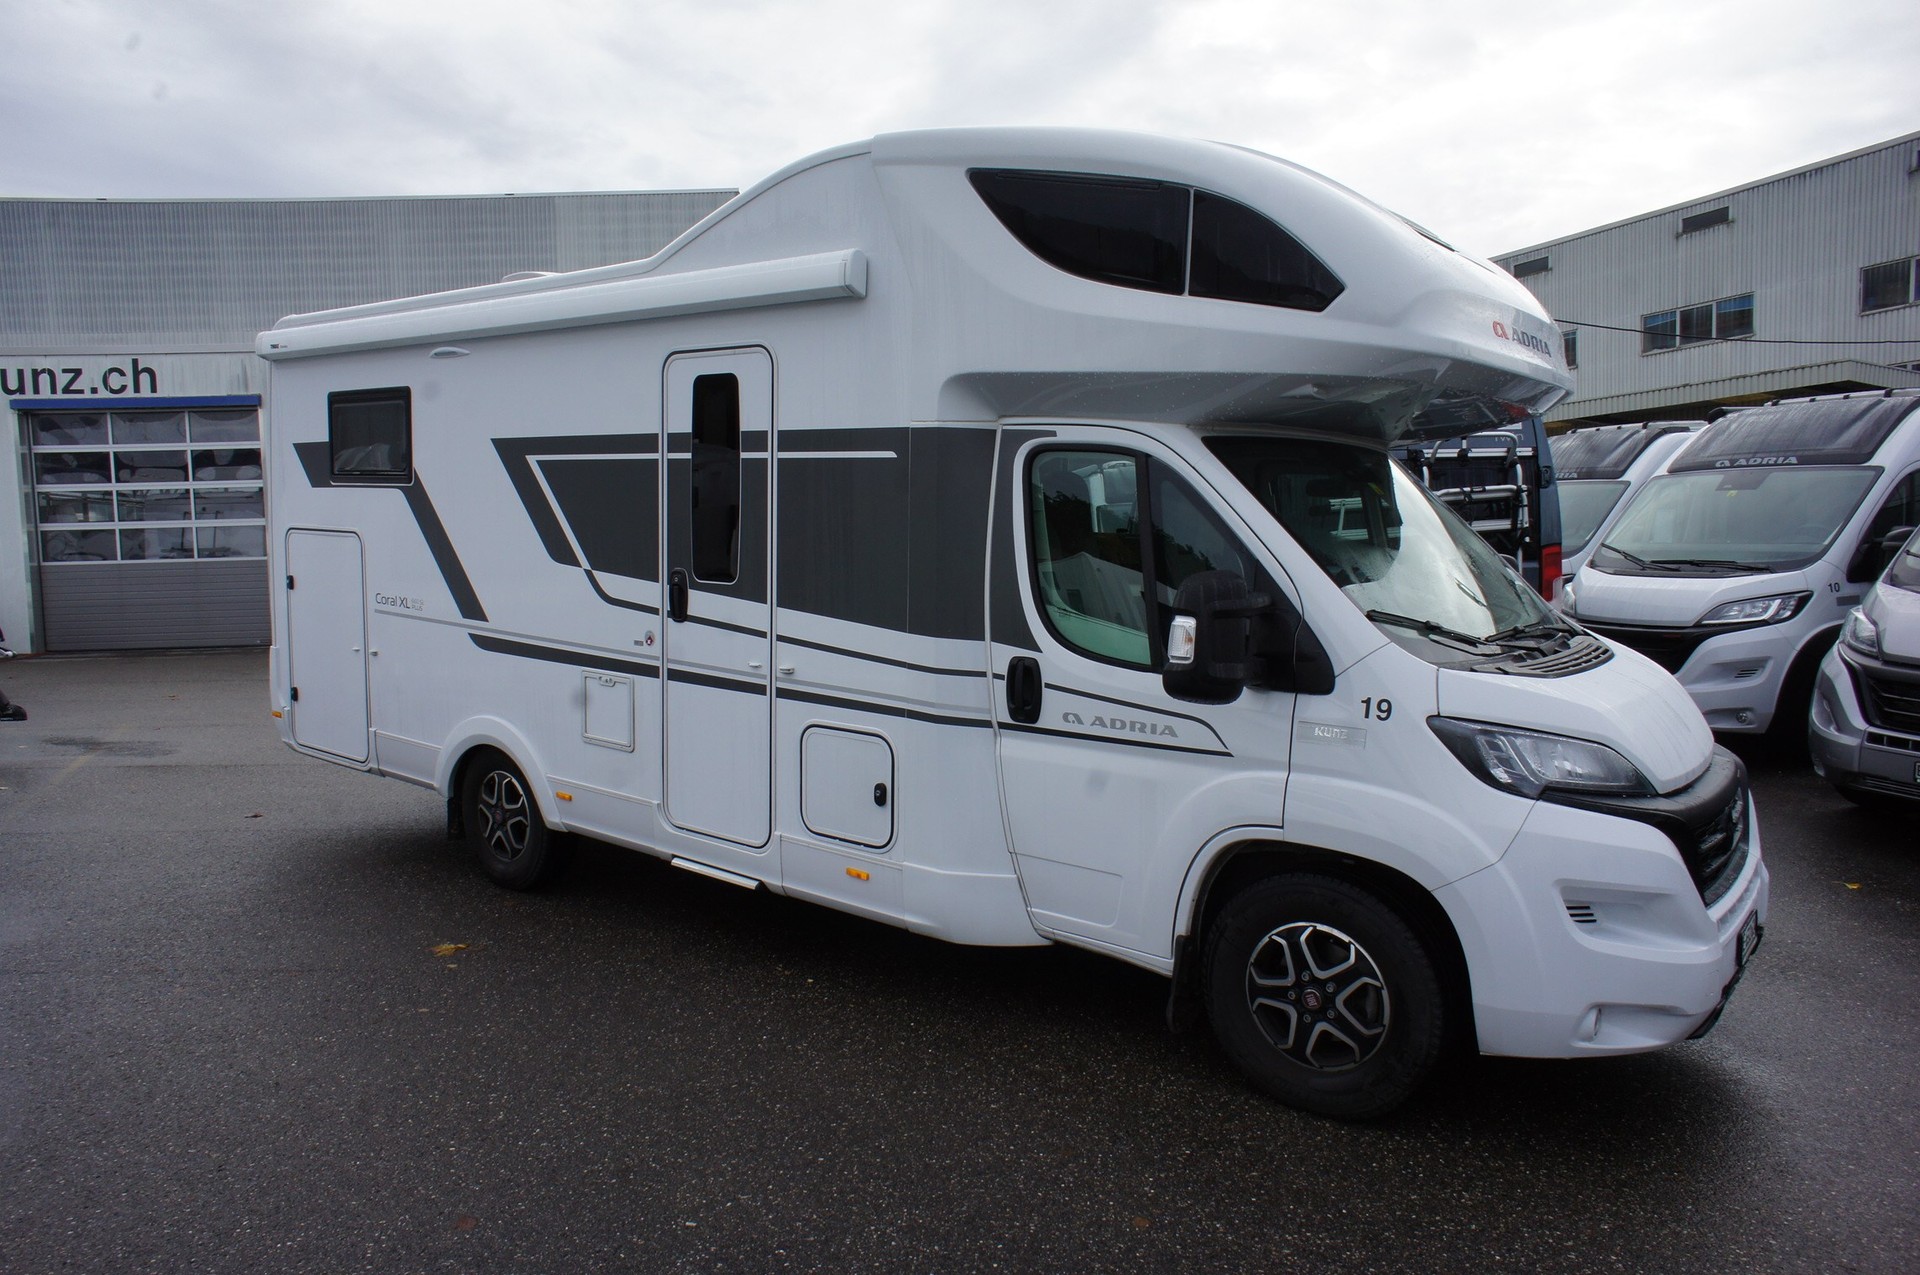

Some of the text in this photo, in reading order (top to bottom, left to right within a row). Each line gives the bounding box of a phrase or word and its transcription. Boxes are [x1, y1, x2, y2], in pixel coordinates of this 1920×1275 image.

[1511, 327, 1552, 358] ADRIA
[0, 358, 157, 395] unz.ch
[1733, 456, 1798, 467] ADRIA
[1828, 582, 1840, 593] 10
[375, 592, 398, 607] Coral
[399, 596, 410, 609] XL
[1361, 697, 1392, 721] 19
[1090, 715, 1179, 738] ADRIA
